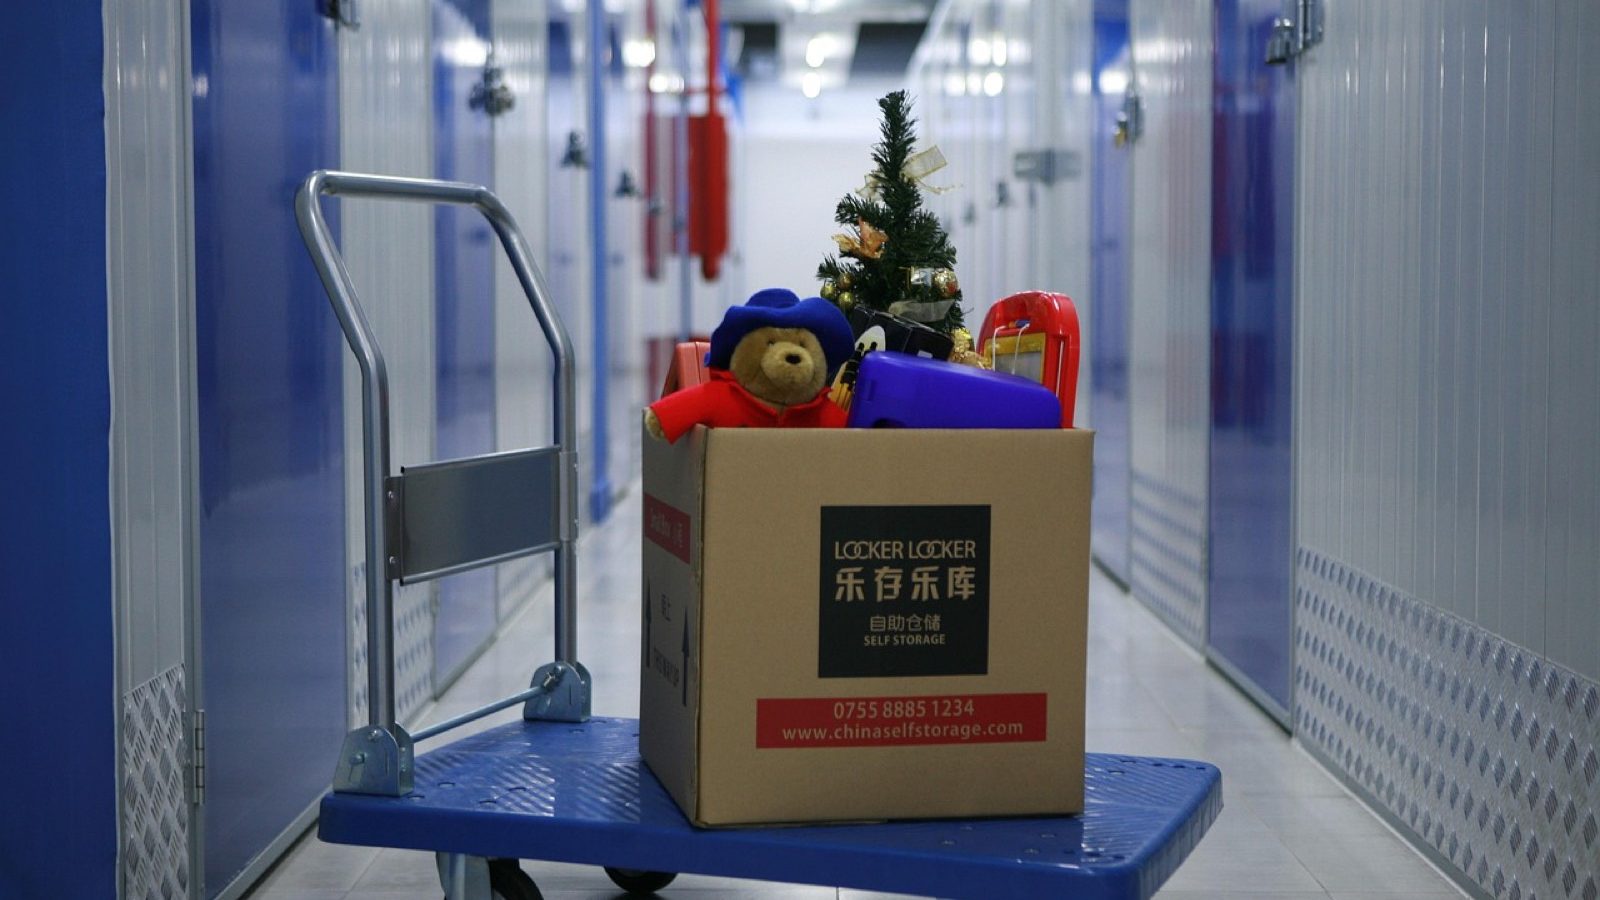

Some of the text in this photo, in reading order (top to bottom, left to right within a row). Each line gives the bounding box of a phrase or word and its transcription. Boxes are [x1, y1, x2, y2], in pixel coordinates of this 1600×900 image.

[835, 540, 976, 559] LOCKER LOCKER
[835, 566, 976, 602] 乐存乐库
[870, 614, 941, 632] 自助仓储
[864, 634, 946, 646] SELF STORAGE
[834, 699, 975, 719] 0755 8885 1234
[782, 721, 1023, 741] www.chinaselfstorage.com
